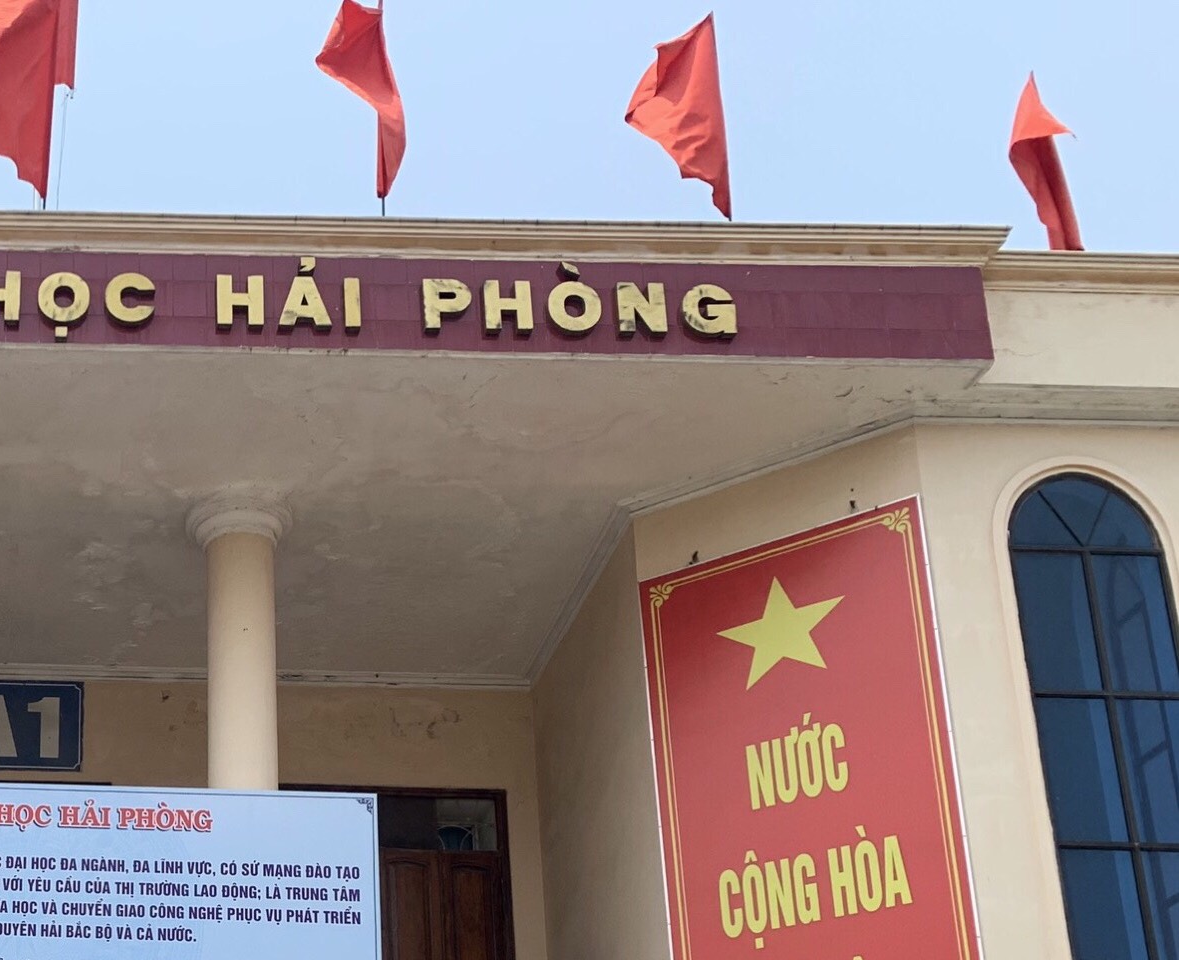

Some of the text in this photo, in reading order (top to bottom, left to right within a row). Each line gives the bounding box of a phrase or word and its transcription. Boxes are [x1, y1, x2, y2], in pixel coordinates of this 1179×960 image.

[216, 257, 362, 332] HẢI
[423, 261, 738, 338] PHÒNG
[745, 712, 848, 810] NƯỚC
[58, 799, 111, 829] HẢI
[117, 802, 213, 832] PHÒNG
[5, 856, 27, 873] ĐẠI
[31, 857, 56, 874] HỌC
[59, 858, 77, 871] ĐA
[80, 855, 129, 874] NGÀNH,
[132, 860, 150, 873] ĐA
[154, 857, 183, 874] LĨNH
[186, 862, 216, 878] VỰC,
[220, 859, 237, 876] CÓ
[241, 860, 260, 876] SỨ
[262, 864, 301, 881] MẠNG
[305, 862, 331, 878] ĐÀO
[335, 866, 360, 883] TẠO
[2, 874, 23, 891] VỚI
[27, 875, 51, 892] YÊU
[55, 874, 80, 893] CẦU
[84, 877, 111, 894] CỦA
[114, 881, 134, 898] THỊ
[138, 878, 189, 896] TRƯỜNG
[193, 884, 217, 897] LAO
[221, 881, 261, 902] ĐỘNG;
[265, 882, 281, 899] LÀ
[284, 886, 328, 900] TRUNG
[332, 884, 360, 902] TÂM
[718, 825, 913, 949] CỘNG HÒA
[12, 901, 37, 918] HỌC
[41, 898, 57, 915] VÀ
[61, 897, 111, 917] CHUYỂN
[115, 904, 145, 918] GIAO
[149, 902, 184, 919] CÔNG
[188, 903, 223, 924] NGHỆ
[226, 908, 261, 925] PHỤC
[265, 909, 282, 926] VỤ
[286, 906, 319, 923] PHÁT
[322, 905, 361, 925] TRIỂN
[40, 921, 61, 938] HẢI
[65, 920, 91, 938] BẮC
[95, 922, 112, 942] BỘ
[116, 923, 132, 940] VÀ
[136, 924, 153, 940] CẢ
[157, 924, 196, 942] NƯỚC.
